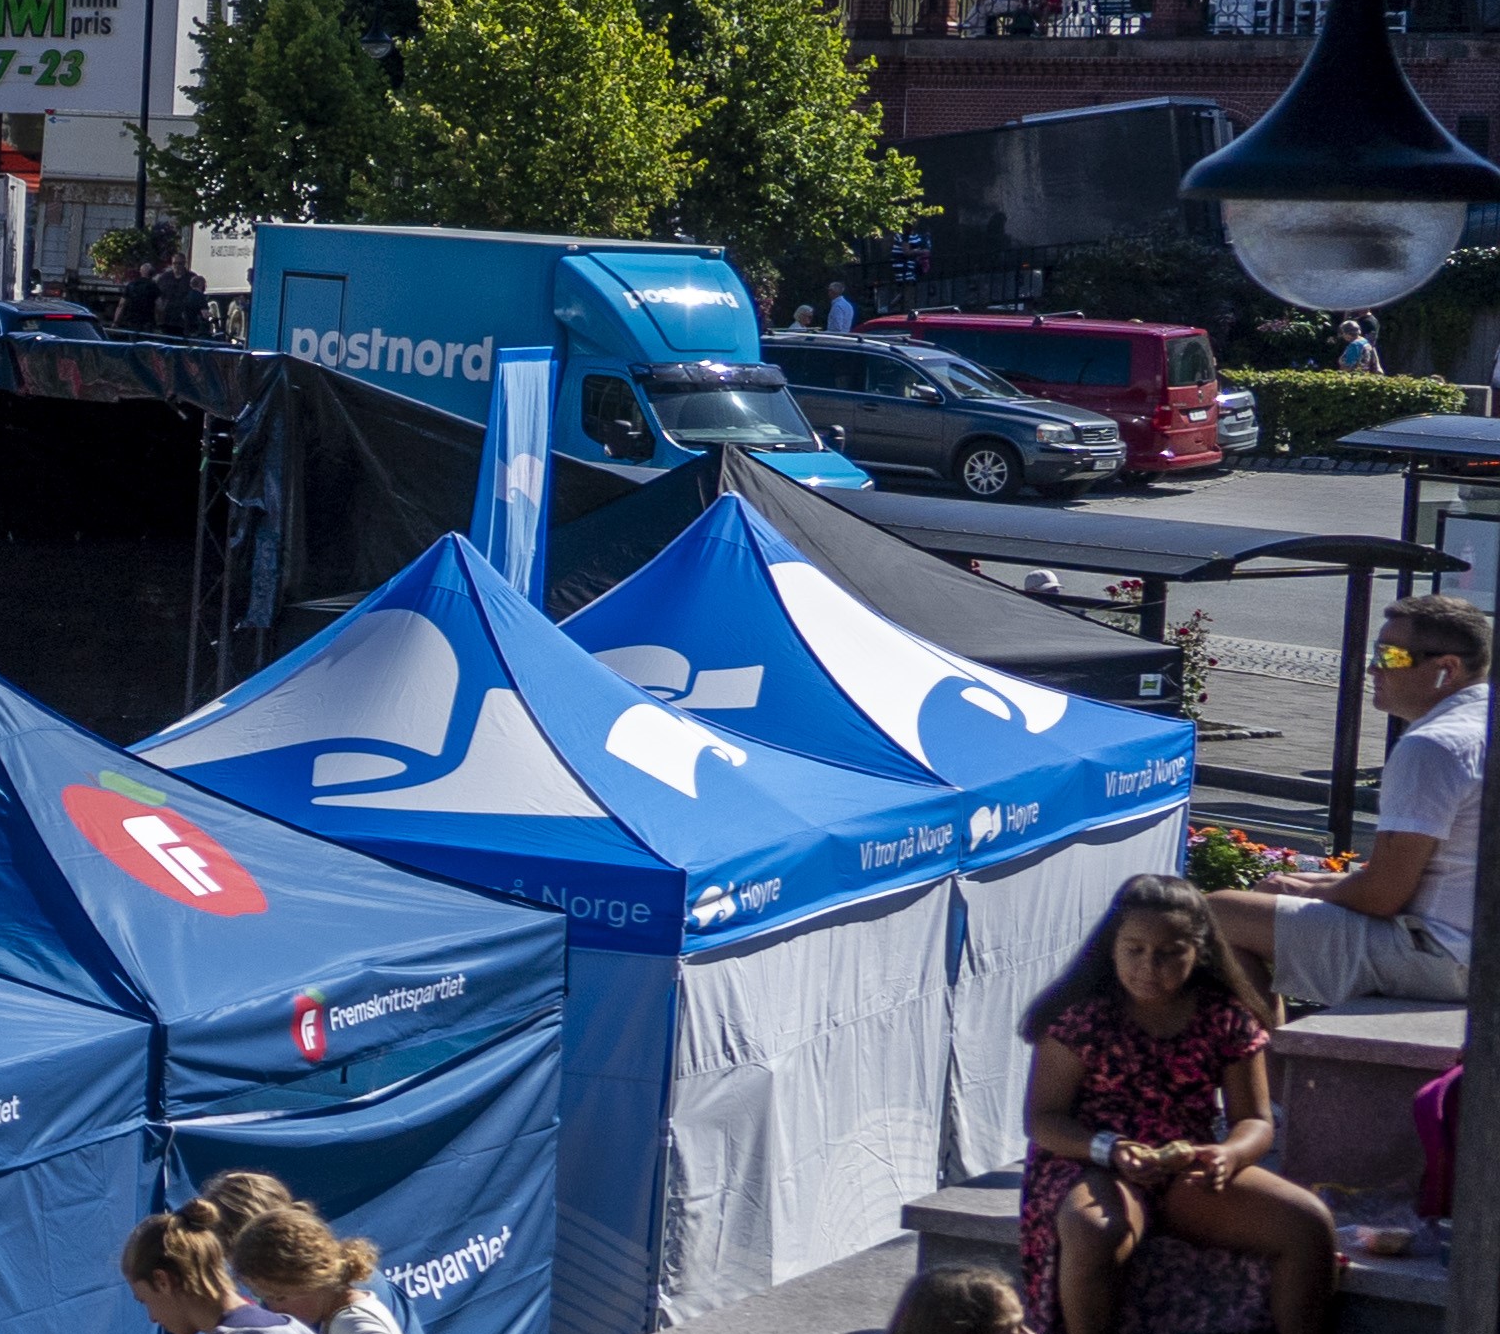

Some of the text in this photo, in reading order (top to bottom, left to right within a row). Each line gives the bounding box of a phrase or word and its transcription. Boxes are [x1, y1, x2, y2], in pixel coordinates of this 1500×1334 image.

[71, 12, 111, 39] pris
[292, 326, 493, 382] postnord
[1105, 755, 1187, 800] Vi tror på Norge
[1006, 801, 1040, 832] Høyre
[860, 821, 954, 871] Vi tror på Norge
[542, 884, 652, 927] Norge
[739, 877, 781, 913] Høyre
[328, 972, 467, 1032] Fremskrittspartiet
